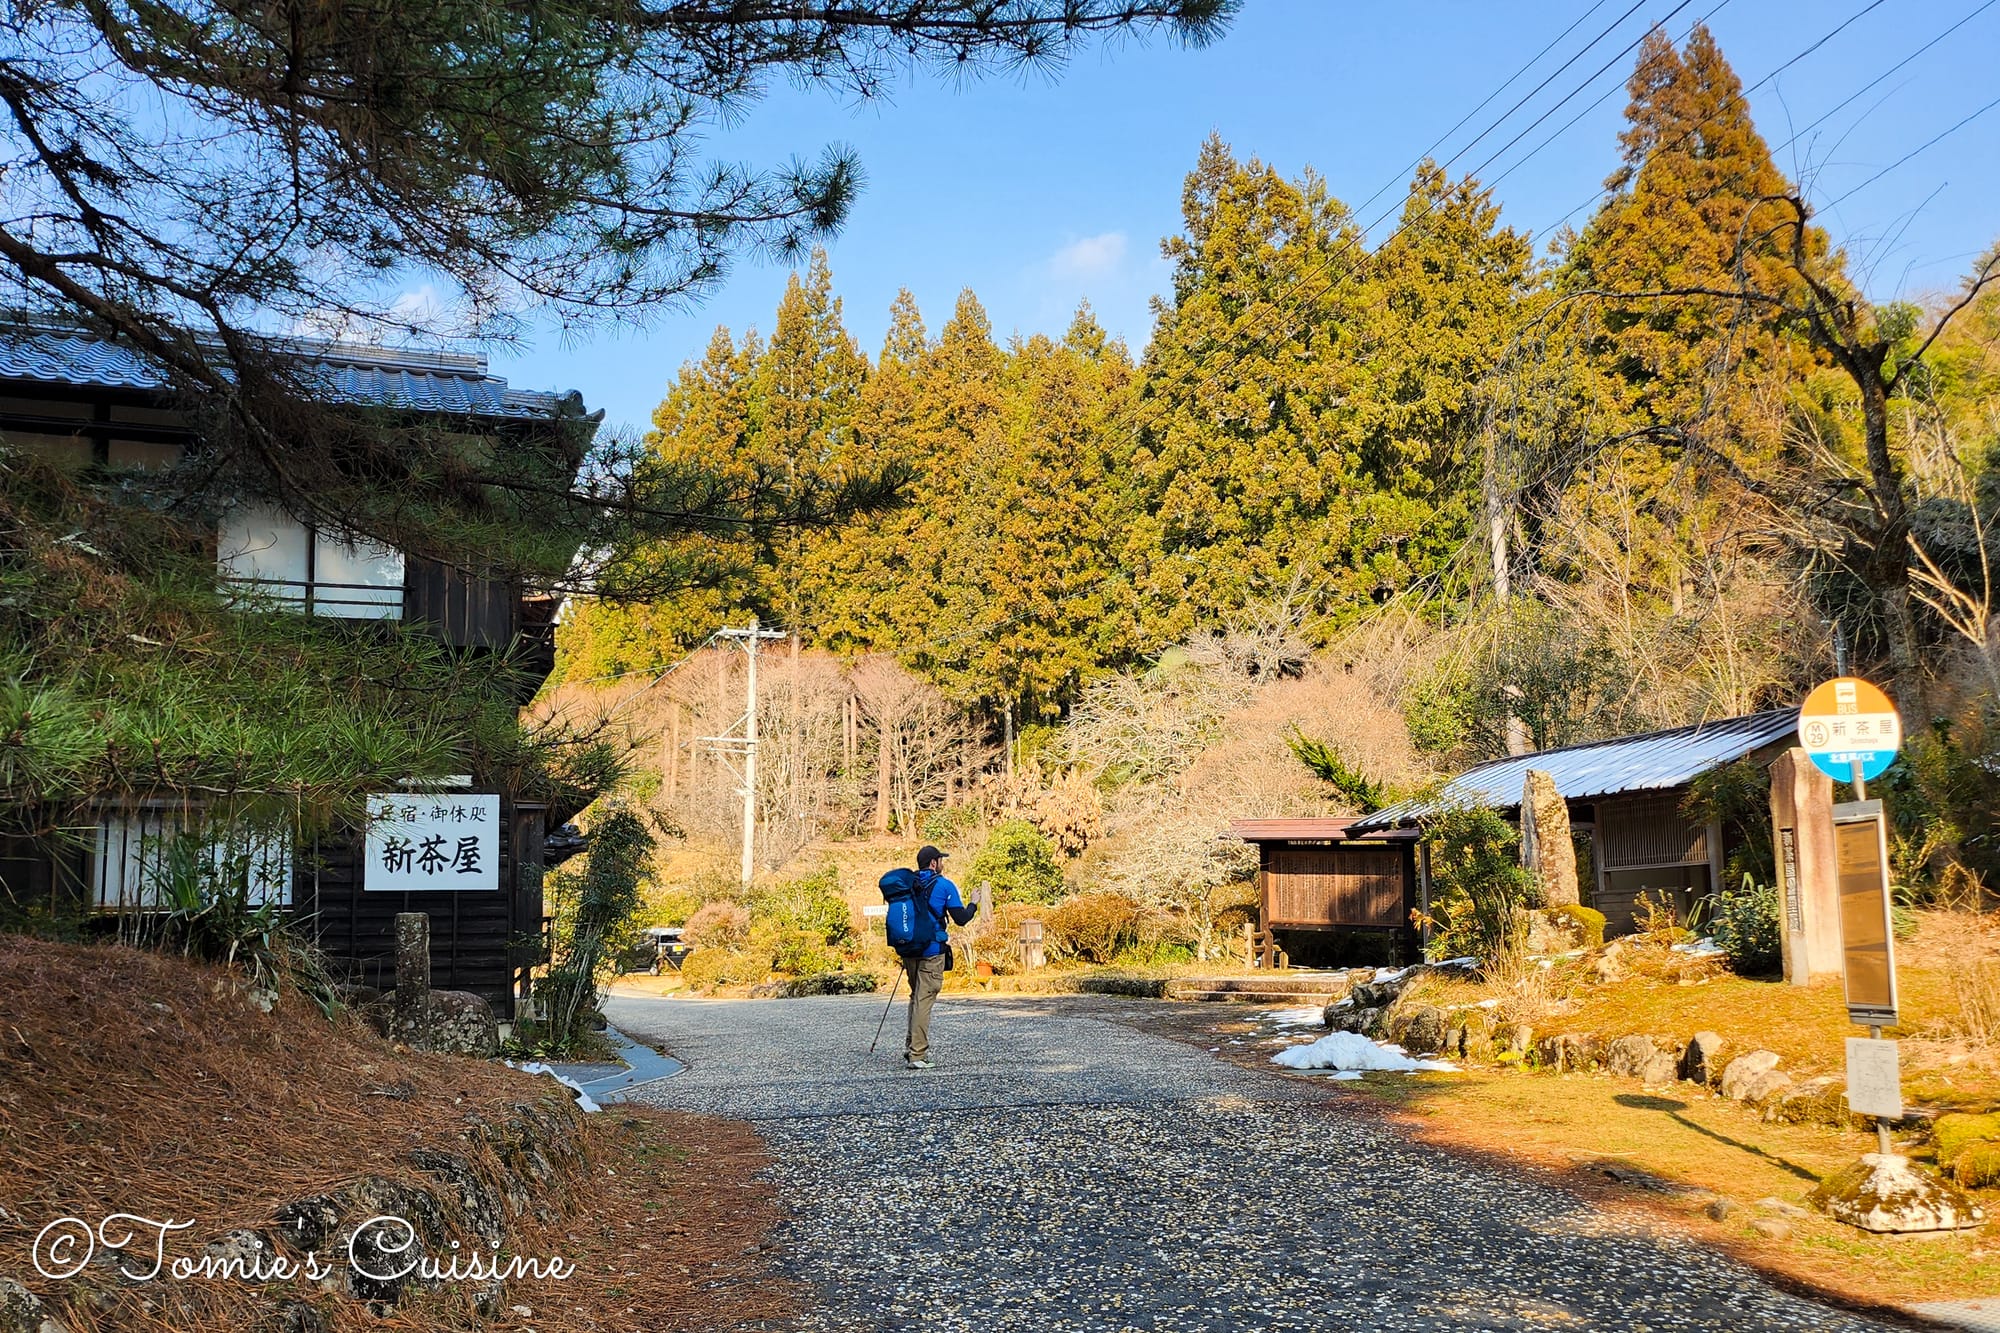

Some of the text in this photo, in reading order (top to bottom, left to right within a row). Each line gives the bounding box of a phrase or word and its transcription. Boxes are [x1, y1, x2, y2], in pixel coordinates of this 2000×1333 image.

[1838, 703, 1858, 714] BUS
[1832, 719, 1894, 737] 新茶屋
[1809, 733, 1824, 744] 29
[381, 833, 484, 876] 新茶屋
